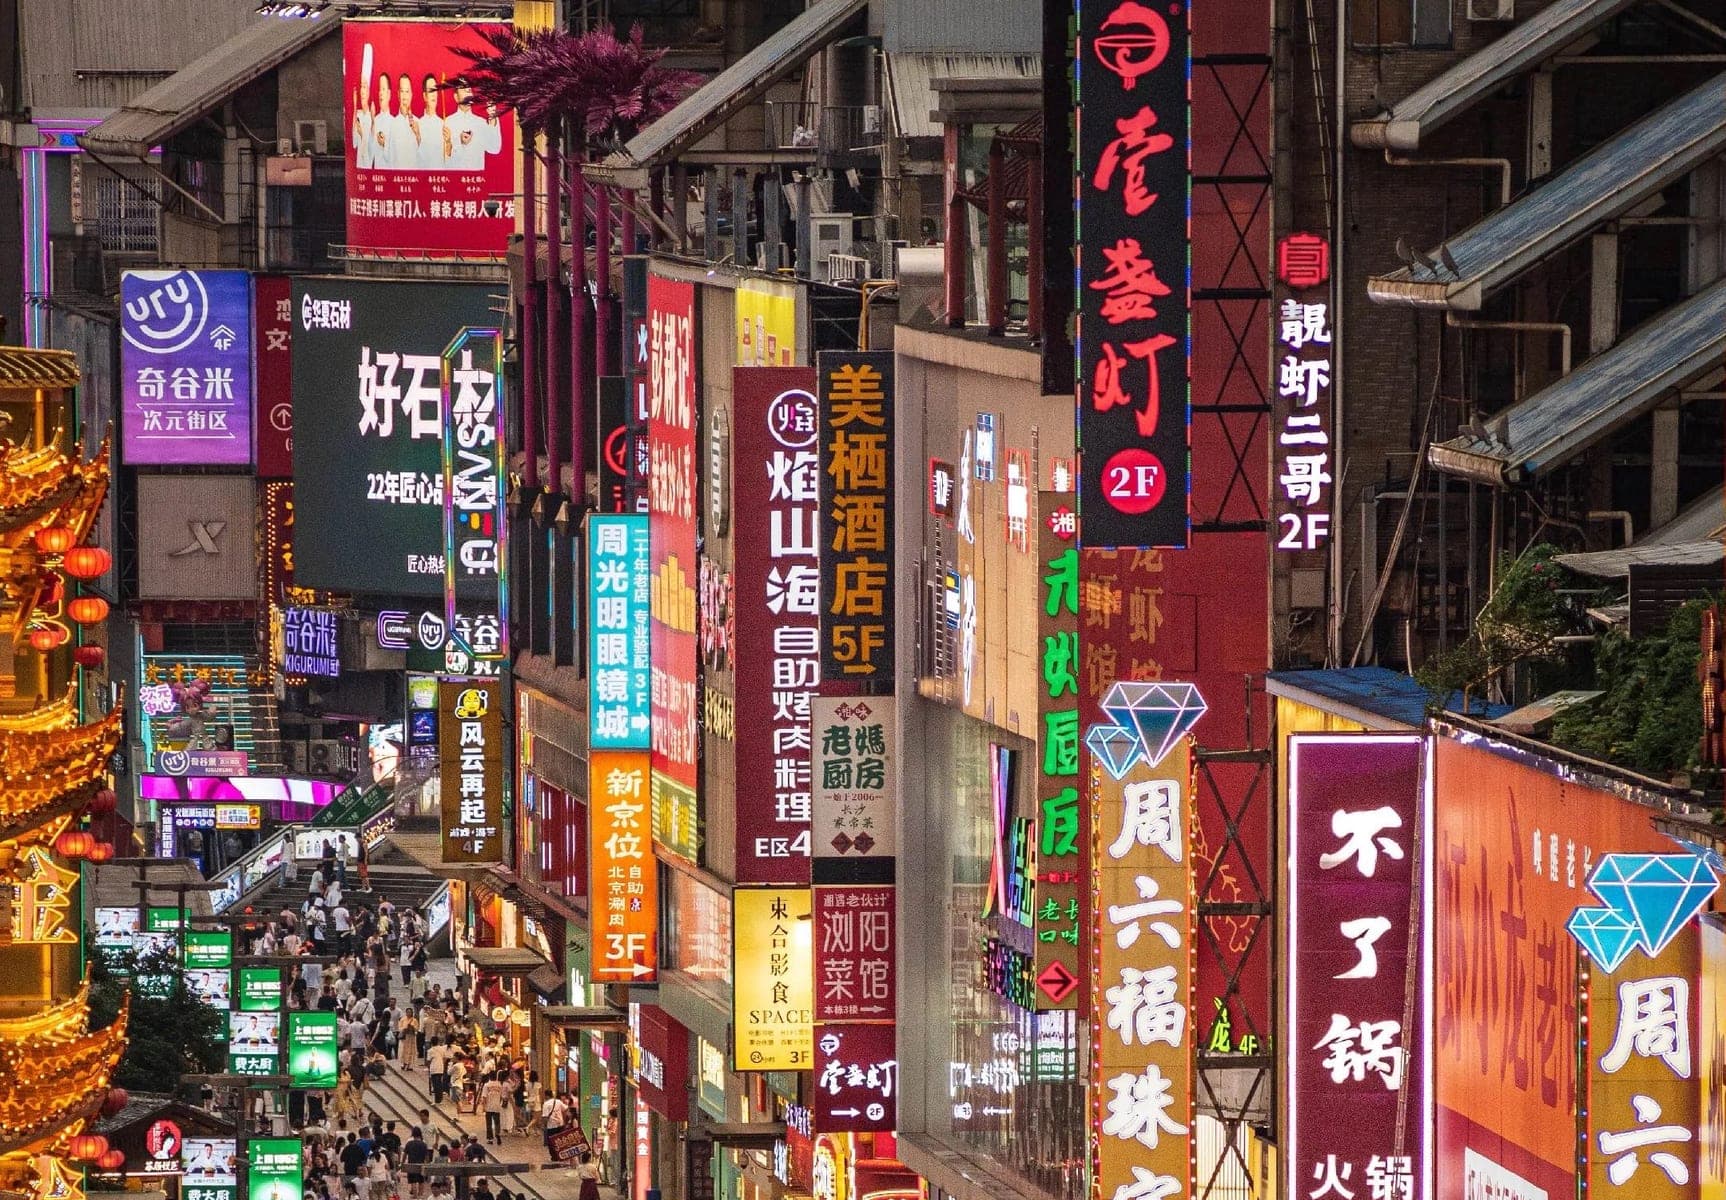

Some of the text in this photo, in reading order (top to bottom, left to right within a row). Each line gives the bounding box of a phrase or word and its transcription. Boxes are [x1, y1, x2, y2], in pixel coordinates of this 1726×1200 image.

[214, 338, 232, 350] 4F
[136, 367, 234, 400] 奇谷米
[143, 410, 228, 431] 次元街区
[828, 364, 888, 616] 美栖酒店
[1109, 466, 1159, 498] 2F
[1279, 512, 1330, 550] 2F
[596, 524, 629, 739] 周光明眼镜城
[833, 625, 885, 662] 5F
[285, 654, 330, 677] KIGURUMI
[822, 724, 886, 756] 老媽
[460, 722, 486, 824] 风云再起
[822, 757, 885, 790] 厨房
[604, 768, 643, 859] 新京位
[627, 866, 644, 895] 自助
[605, 933, 647, 961] 3F
[823, 911, 889, 953] 浏阳
[1313, 806, 1407, 1090] 不了锅
[823, 957, 889, 1000] 菜馆
[750, 1009, 810, 1024] SPACE
[790, 1051, 810, 1064] 3F
[1239, 1035, 1257, 1055] 4F
[235, 1056, 273, 1071] 费大厨
[869, 1107, 882, 1117] 2F
[1309, 1154, 1415, 1200] 火锅
